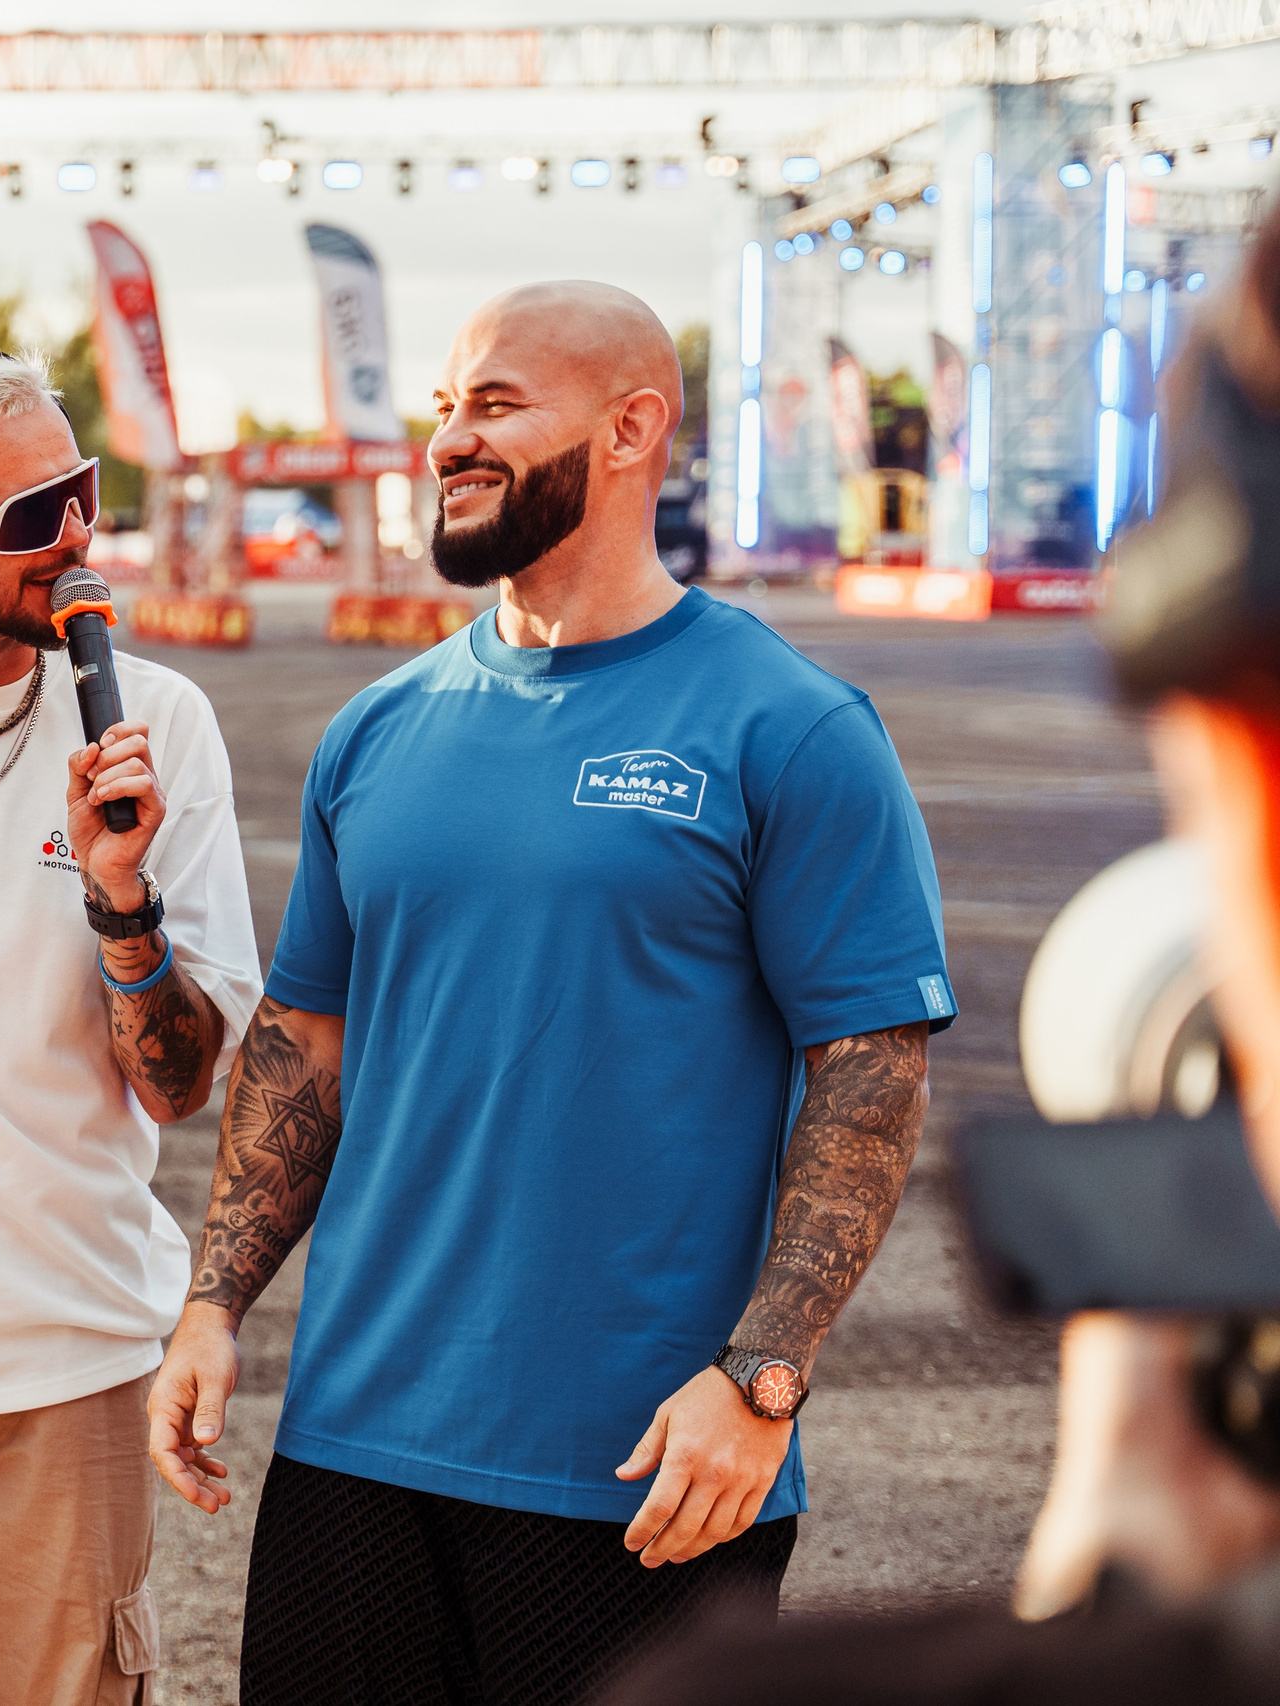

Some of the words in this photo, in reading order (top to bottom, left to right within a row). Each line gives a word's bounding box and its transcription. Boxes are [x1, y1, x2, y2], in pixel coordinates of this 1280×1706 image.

[620, 755, 669, 773] Team
[588, 774, 689, 798] KAMAZ
[608, 791, 666, 806] master
[929, 979, 946, 1016] KAMAZ
[331, 1521, 357, 1545] KITH
[358, 1499, 387, 1527] KITH
[338, 1495, 367, 1523] KITH
[323, 1545, 349, 1569] KITH
[350, 1523, 378, 1551] KITH
[379, 1504, 407, 1530] KITH
[340, 1548, 369, 1575] KITH
[370, 1527, 399, 1554] KITH
[502, 1528, 530, 1557] KITH
[522, 1529, 552, 1561] KITH
[333, 1573, 359, 1598] KITH
[360, 1550, 391, 1579] KITH
[516, 1556, 544, 1585] KITH
[544, 1531, 574, 1563] KITH
[292, 1585, 318, 1608] KITH
[342, 1600, 370, 1626] KITH
[372, 1576, 402, 1605] KITH
[511, 1582, 536, 1608] KITH
[536, 1557, 567, 1588] KITH
[523, 1610, 551, 1638] KITH
[551, 1585, 582, 1616] KITH
[581, 1559, 610, 1591] KITH
[530, 1584, 559, 1612] KITH
[559, 1558, 589, 1590] KITH
[277, 1629, 302, 1654] KITH
[302, 1612, 327, 1637] KITH
[351, 1575, 381, 1604] KITH
[383, 1554, 411, 1580] KITH
[284, 1607, 310, 1631] KITH
[362, 1601, 392, 1629] KITH
[516, 1634, 545, 1662] KITH
[543, 1611, 574, 1642] KITH
[573, 1586, 604, 1618] KITH
[603, 1560, 633, 1592] KITH
[294, 1635, 320, 1659] KITH
[352, 1624, 382, 1654] KITH
[383, 1602, 413, 1631] KITH
[372, 1627, 402, 1654] KITH
[393, 1627, 423, 1655] KITH
[512, 1659, 538, 1686] KITH
[538, 1638, 566, 1666] KITH
[565, 1613, 596, 1644] KITH
[596, 1588, 626, 1619] KITH
[531, 1662, 559, 1691] KITH
[558, 1639, 589, 1669] KITH
[588, 1614, 618, 1646] KITH
[618, 1588, 648, 1620] KITH
[553, 1665, 581, 1694] KITH
[580, 1640, 610, 1671] KITH
[610, 1615, 640, 1646] KITH
[640, 1589, 669, 1620] KITH
[382, 1650, 413, 1677] KITH
[392, 1674, 422, 1702] KITH
